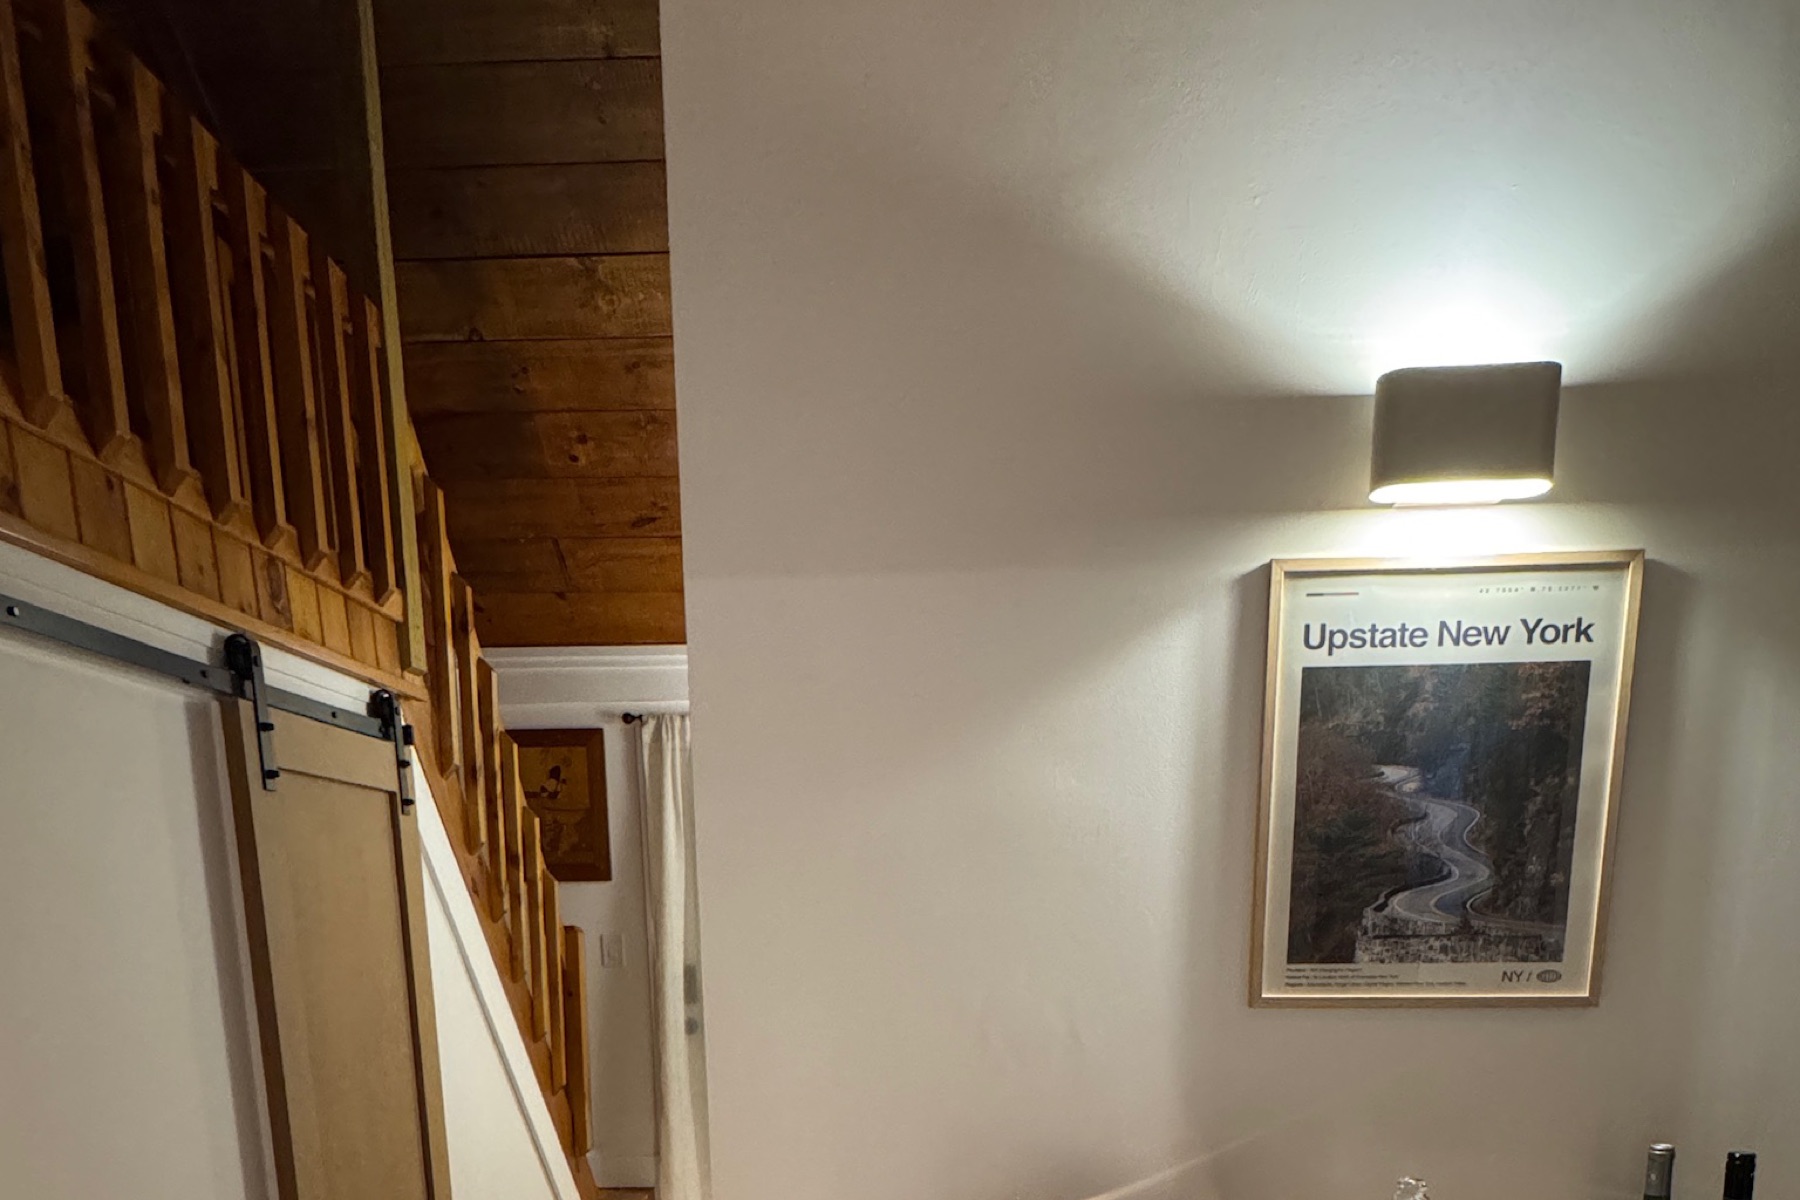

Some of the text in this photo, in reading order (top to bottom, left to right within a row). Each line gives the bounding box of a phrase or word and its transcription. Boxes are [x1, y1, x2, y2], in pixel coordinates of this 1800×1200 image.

[1303, 617, 1595, 656] Upstate New York
[1501, 969, 1524, 982] NY
